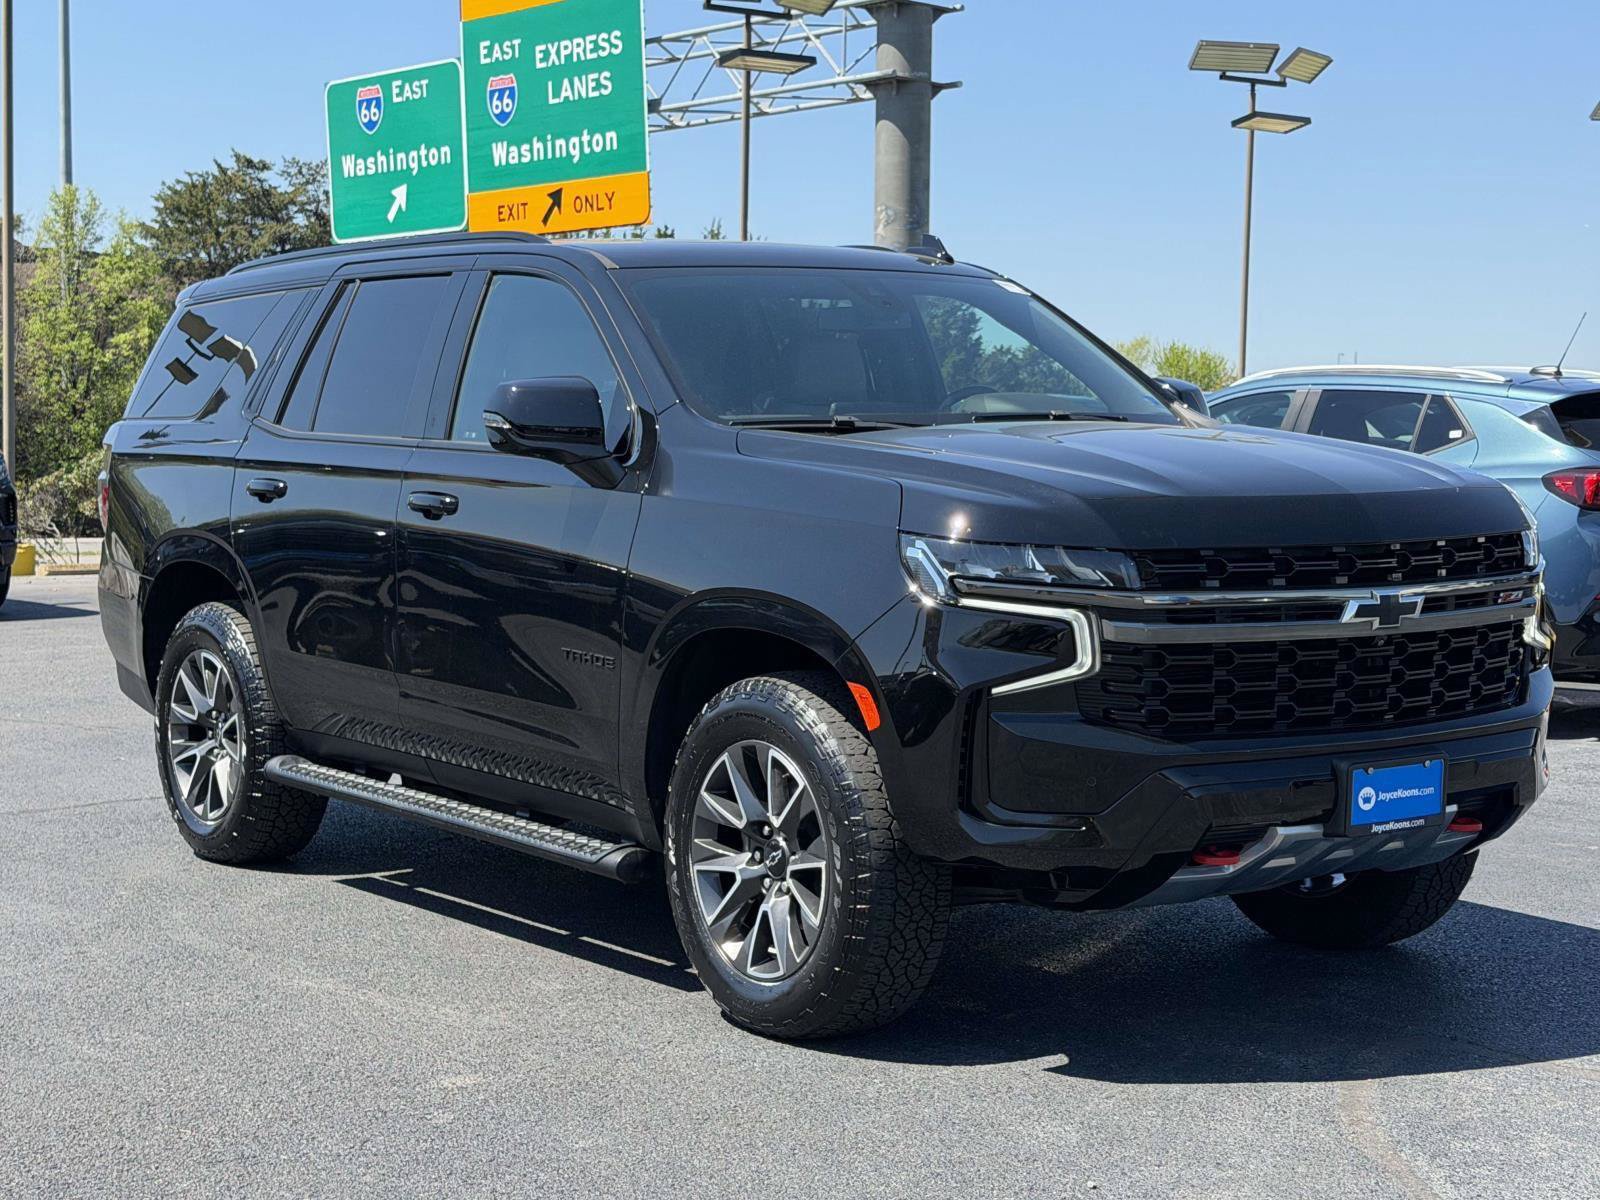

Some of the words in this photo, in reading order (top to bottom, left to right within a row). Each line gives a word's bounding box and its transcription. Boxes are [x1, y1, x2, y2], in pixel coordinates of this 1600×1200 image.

[480, 39, 521, 64] EAST
[535, 31, 622, 69] EXPRESS
[392, 79, 429, 103] EAST
[547, 71, 612, 104] LANES
[360, 100, 380, 123] 66
[491, 90, 513, 115] 66
[341, 143, 451, 178] Washington
[491, 129, 618, 167] Washington
[497, 202, 528, 222] EXIT
[573, 192, 615, 214] ONLY
[560, 646, 616, 669] TAHOE
[1377, 786, 1435, 803] JoyceKoons.com
[1371, 818, 1425, 834] JoyceKoons.com
